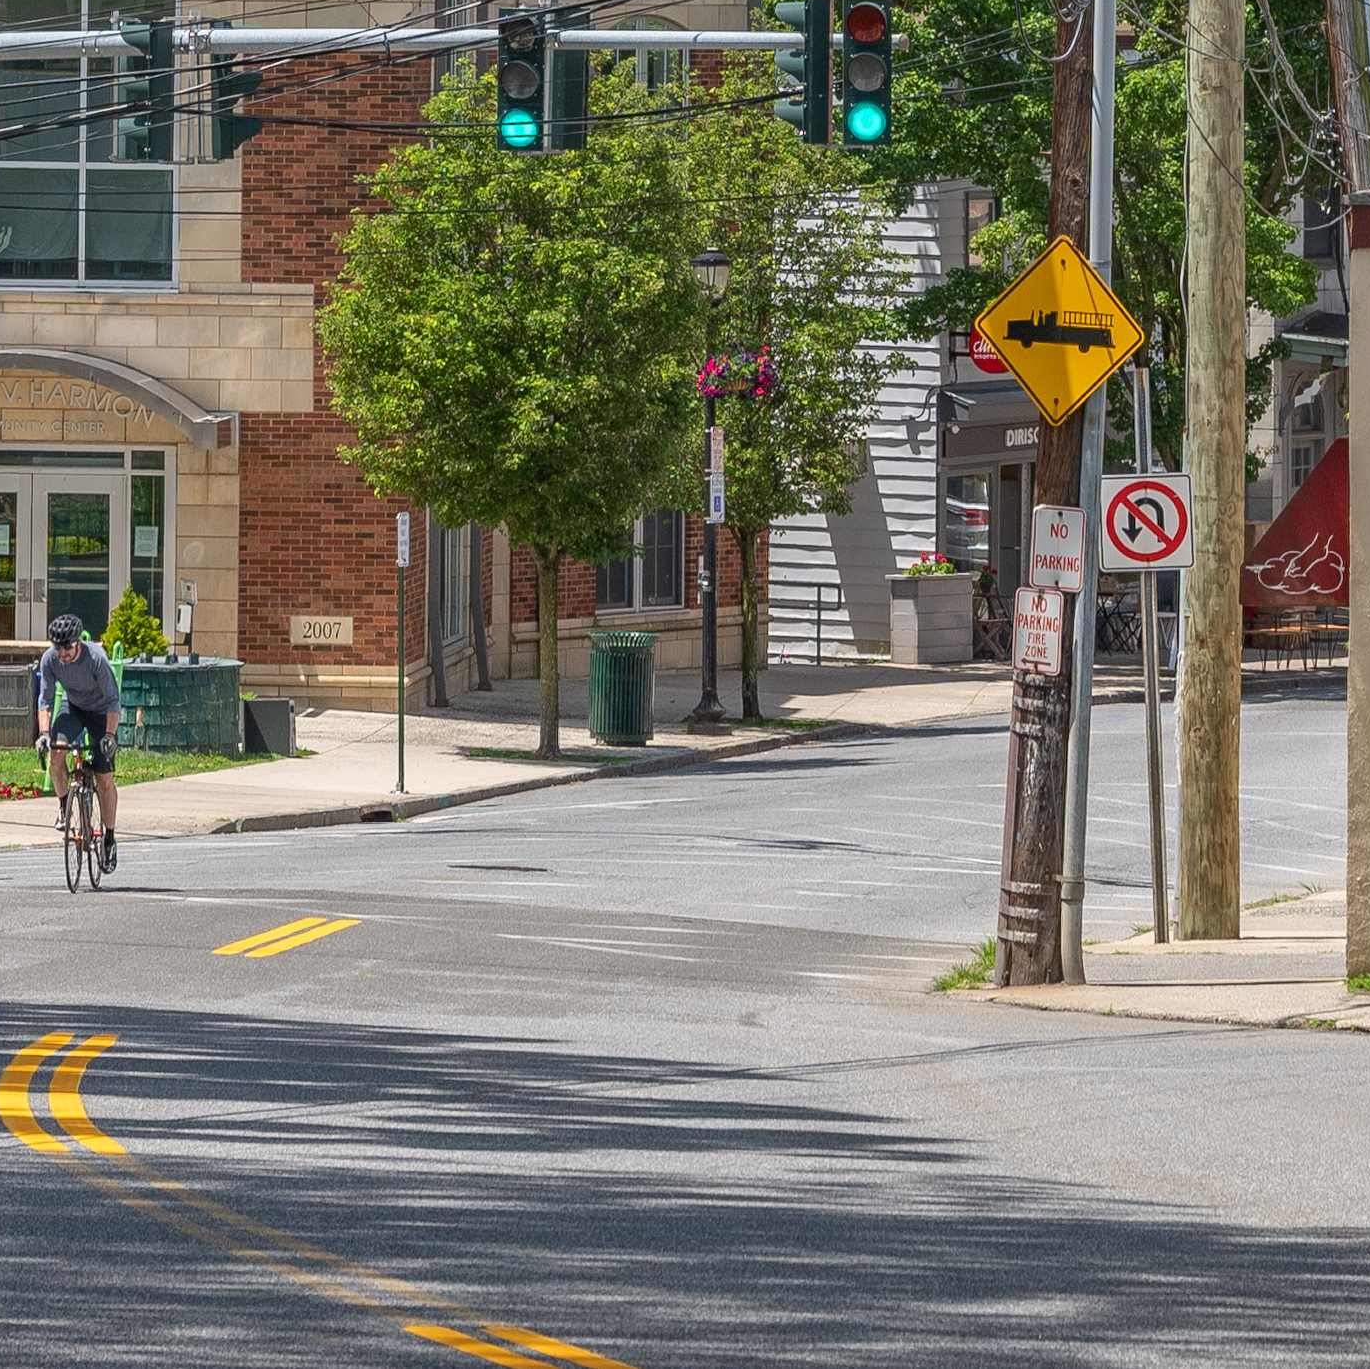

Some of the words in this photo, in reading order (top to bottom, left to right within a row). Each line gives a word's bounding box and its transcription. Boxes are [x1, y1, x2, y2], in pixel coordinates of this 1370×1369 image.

[1, 381, 22, 404] V.
[30, 381, 155, 428] HARMON
[51, 420, 106, 434] CENTER
[1049, 523, 1069, 539] NO
[1035, 554, 1080, 573] PARKING
[1031, 596, 1048, 614] NO
[302, 621, 342, 639] 2007
[1017, 613, 1059, 633] PARKING
[1027, 632, 1047, 646] FIRE
[1025, 645, 1049, 659] ZONE
